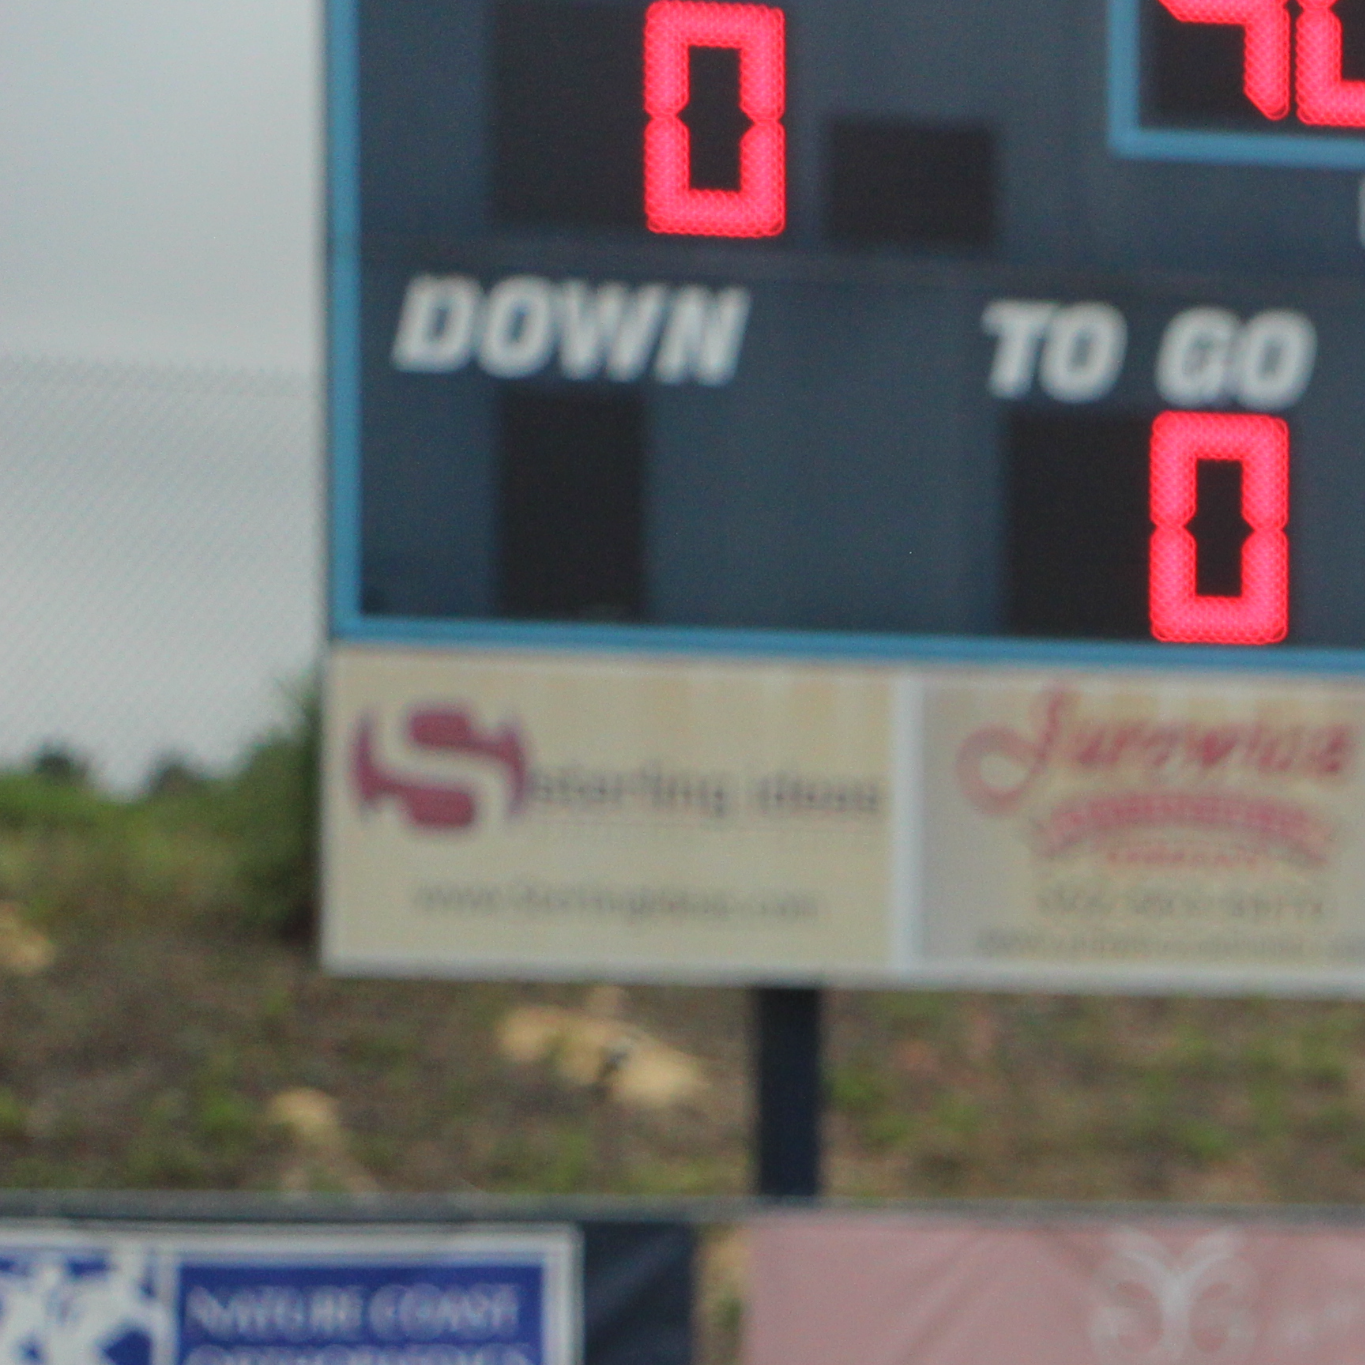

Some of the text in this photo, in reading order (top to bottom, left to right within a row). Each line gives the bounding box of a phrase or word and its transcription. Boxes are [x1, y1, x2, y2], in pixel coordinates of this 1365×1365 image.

[645, 1, 785, 237] 0
[394, 275, 750, 385] DOWN
[984, 301, 1317, 408] TO GO
[1150, 412, 1289, 645] 0
[187, 1285, 518, 1338] NATURE COAST
